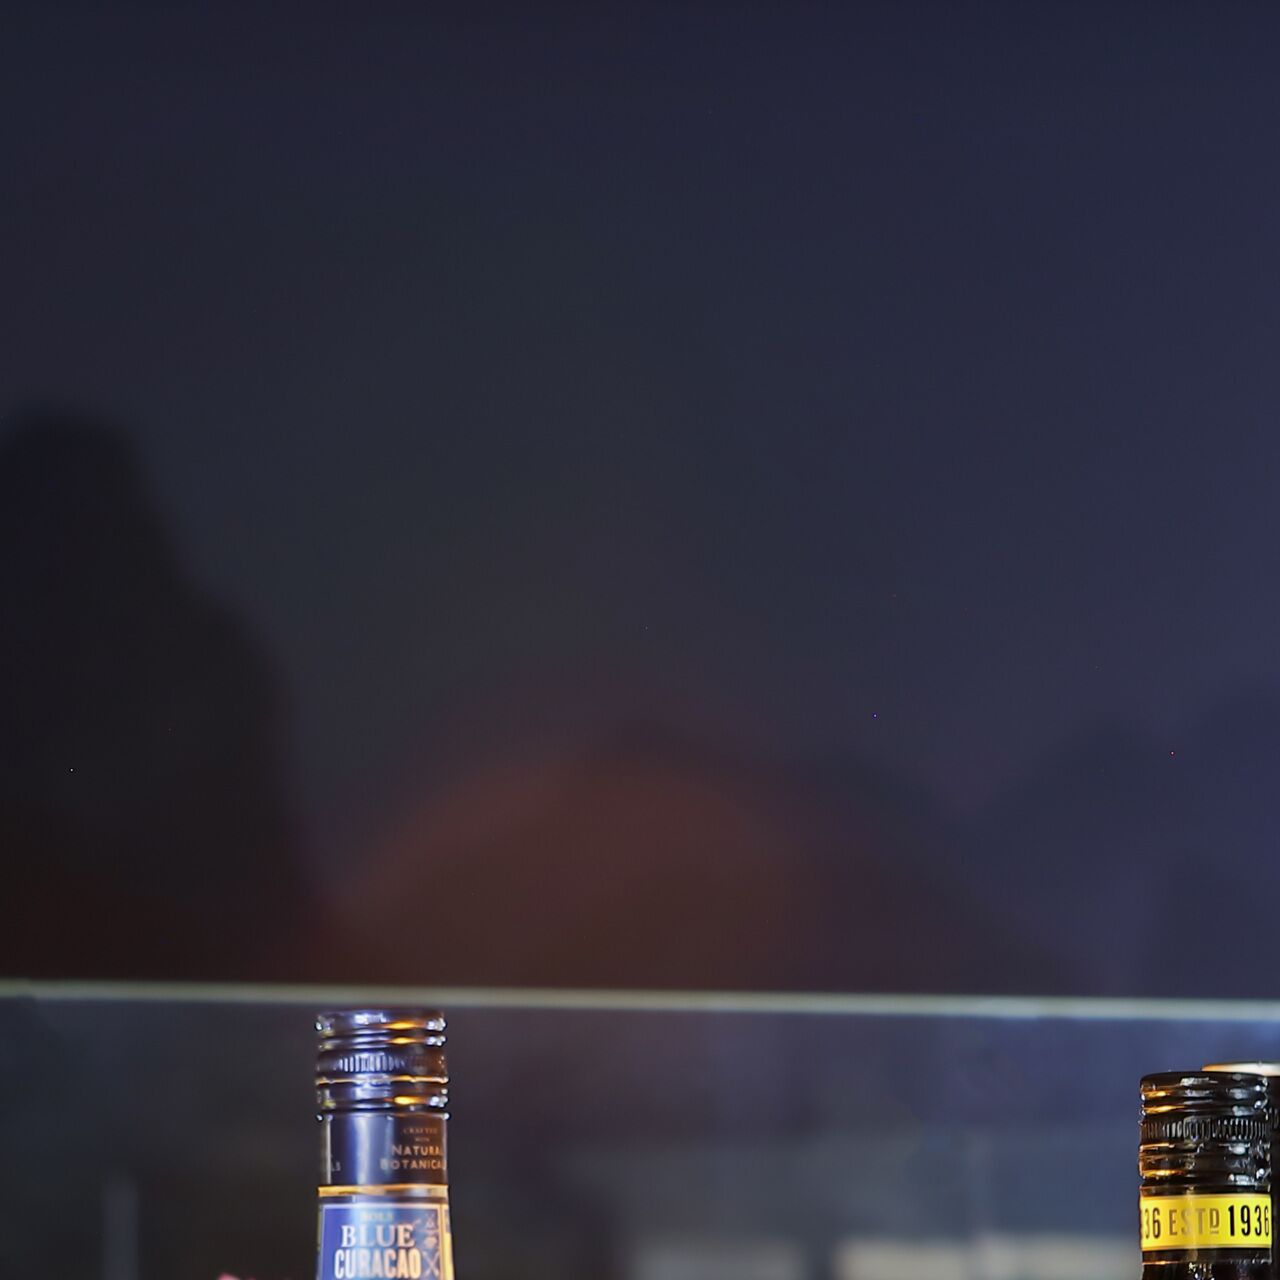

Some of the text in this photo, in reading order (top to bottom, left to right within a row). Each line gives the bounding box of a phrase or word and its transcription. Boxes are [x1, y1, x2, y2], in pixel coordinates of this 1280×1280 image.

[340, 1224, 416, 1248] BLUE
[1228, 1205, 1270, 1237] 1936
[334, 1248, 422, 1280] CURACAO
